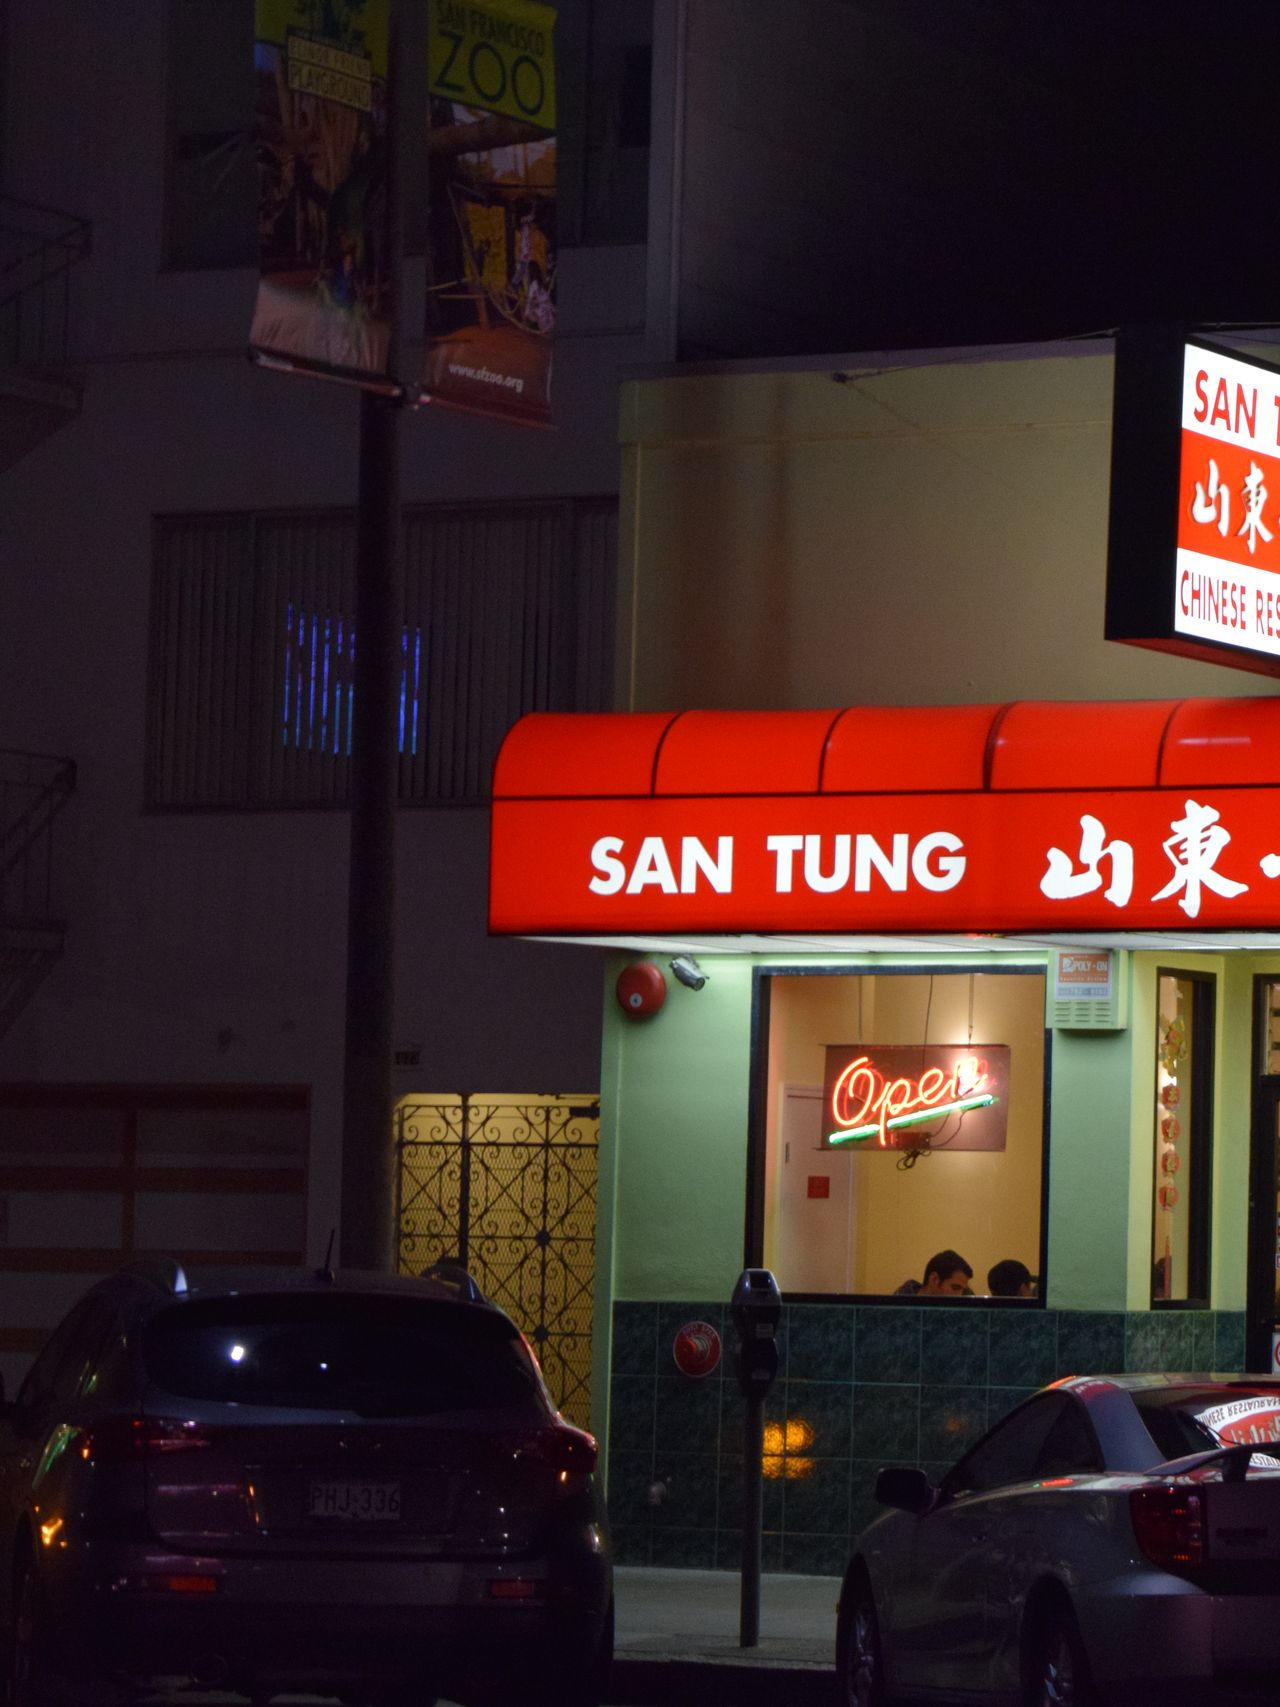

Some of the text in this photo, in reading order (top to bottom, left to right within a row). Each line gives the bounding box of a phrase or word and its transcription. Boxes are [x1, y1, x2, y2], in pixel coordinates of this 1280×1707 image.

[470, 9, 545, 56] FRANCISCO
[435, 29, 544, 115] ZOO
[448, 363, 524, 393] www.sfzoo.org
[1194, 370, 1257, 438] SAN
[1181, 569, 1247, 630] CHINESE
[588, 831, 967, 896] SAN TUNG
[832, 1056, 990, 1147] Open
